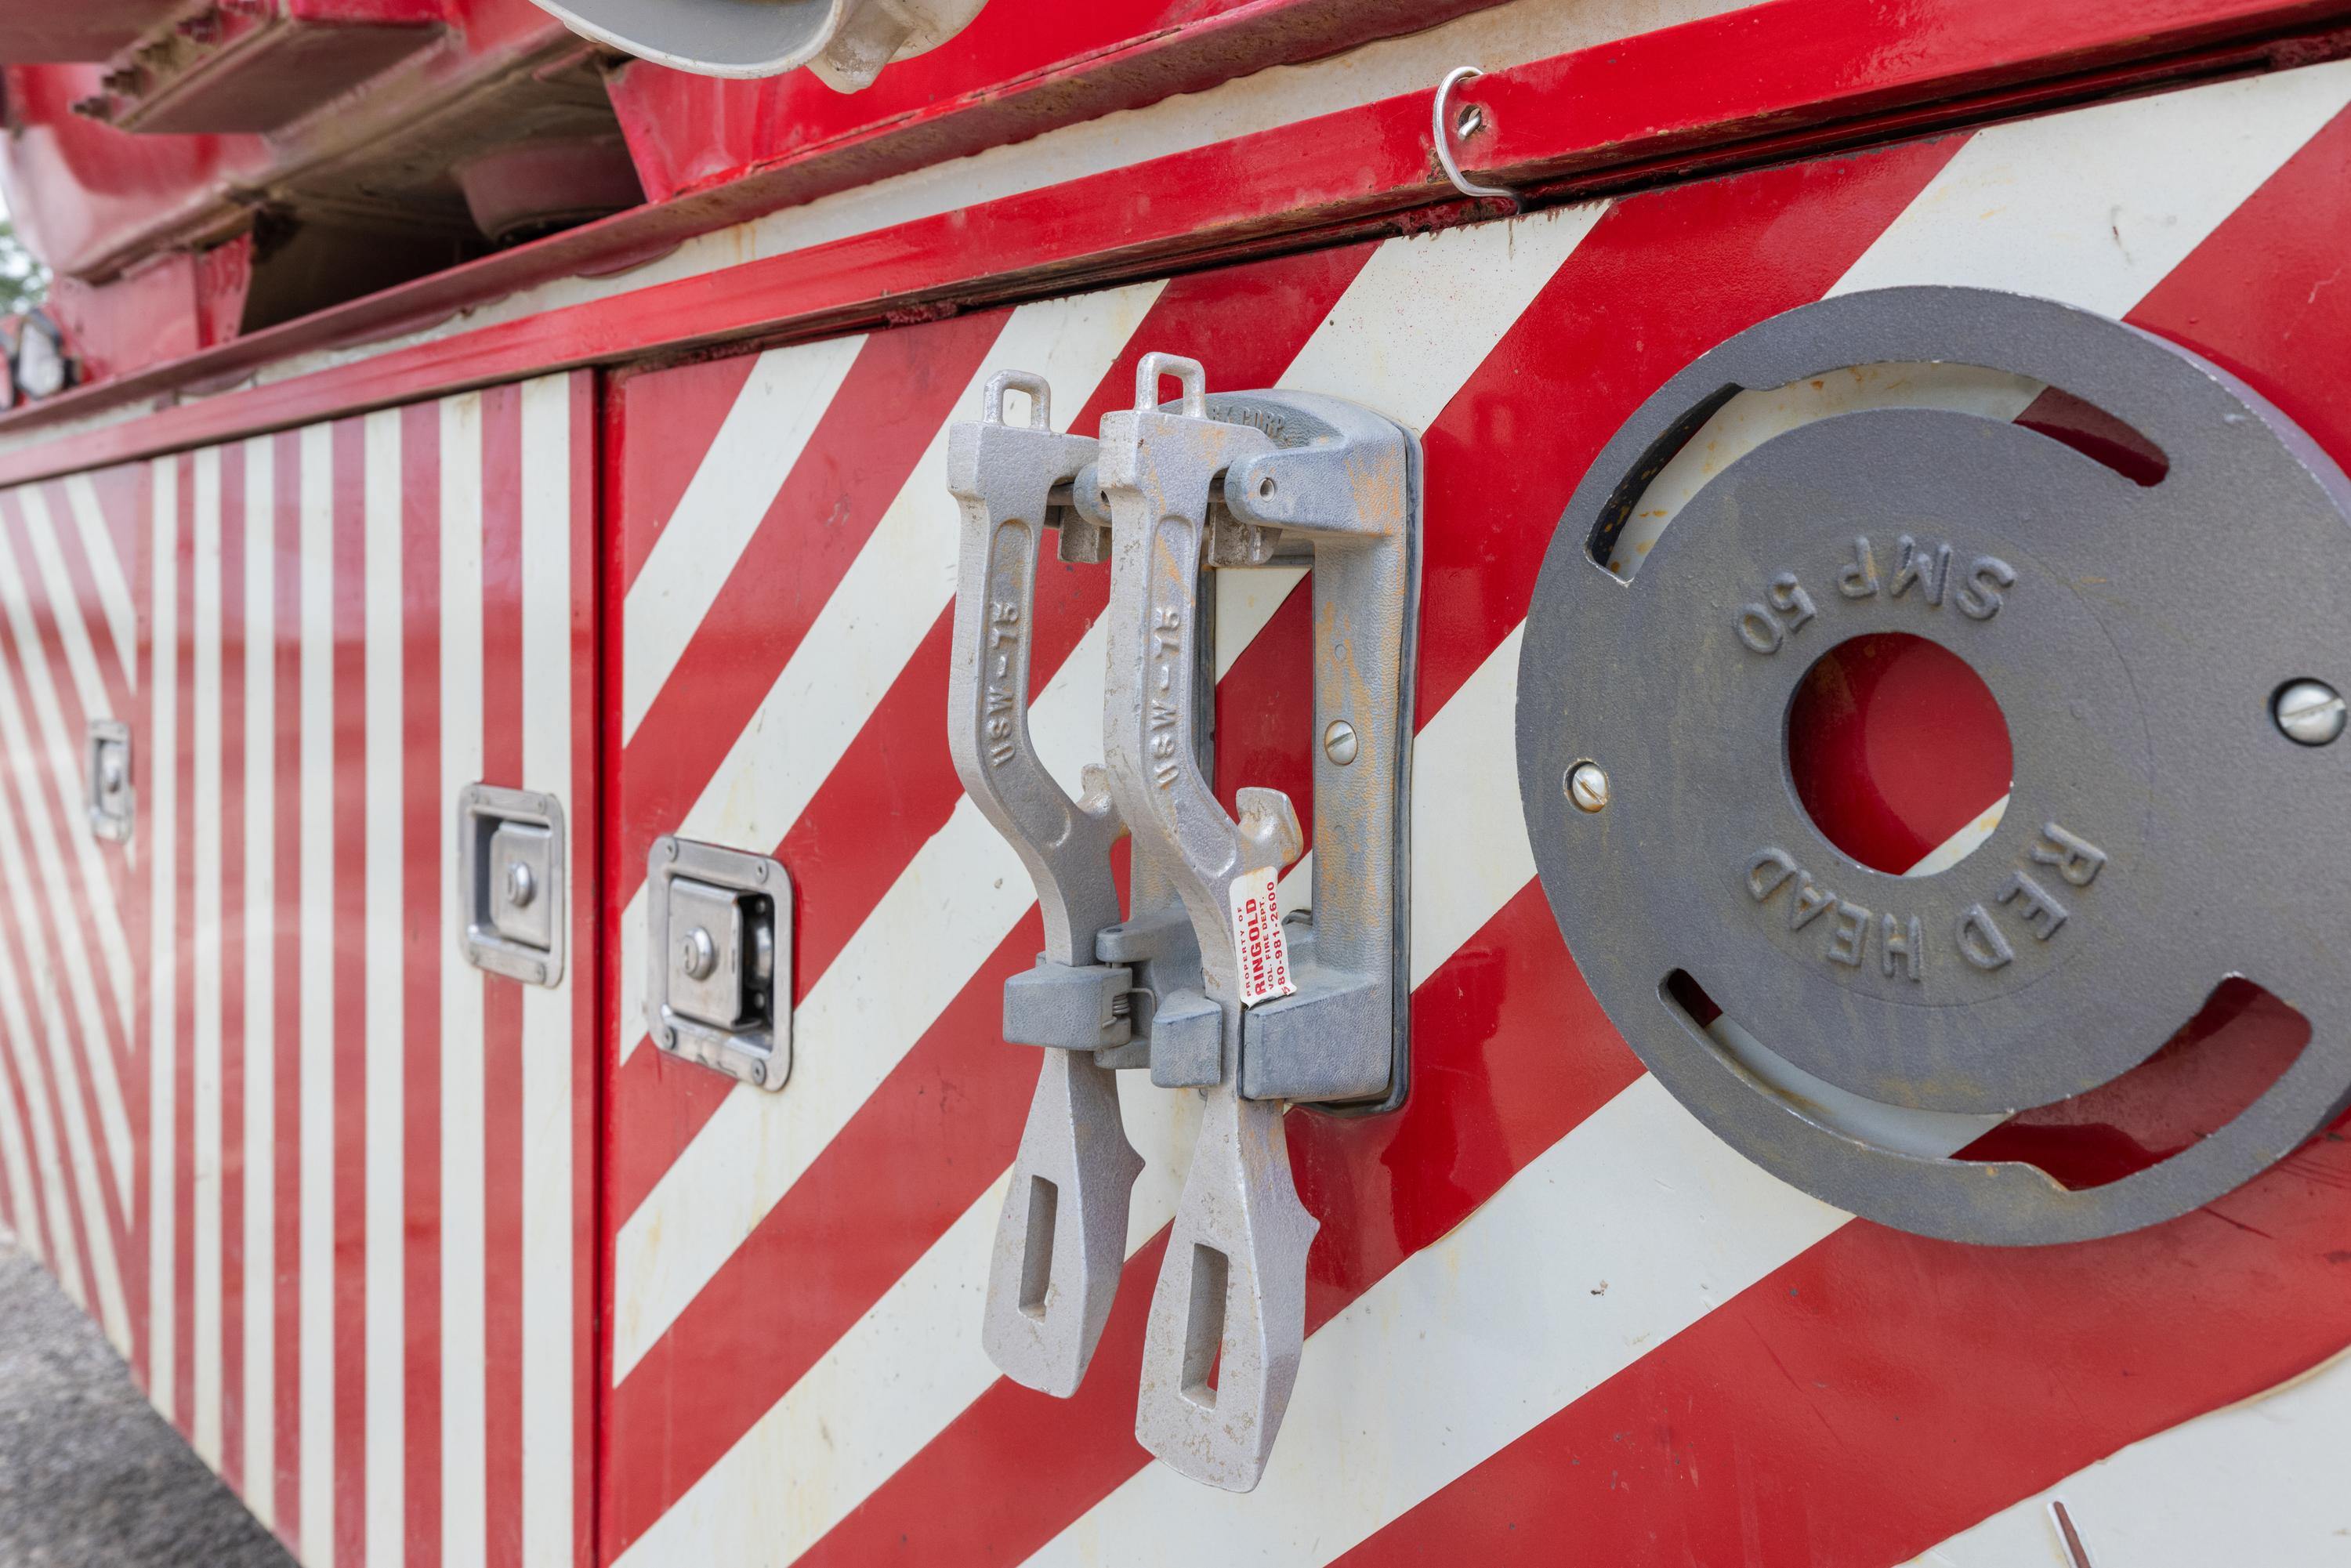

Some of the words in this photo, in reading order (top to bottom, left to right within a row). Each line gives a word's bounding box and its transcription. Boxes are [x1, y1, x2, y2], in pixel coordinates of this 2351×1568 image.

[1736, 570, 1818, 655] 50
[1834, 534, 2019, 621] SMP
[1237, 907, 1244, 922] OF
[1259, 896, 1270, 931] DEPT.
[1744, 844, 1925, 983] HEAD
[1958, 820, 2108, 972] RED
[1240, 930, 1252, 997] PROPERTY
[1245, 898, 1267, 996] RINGOLD
[1262, 932, 1272, 961] FIRE
